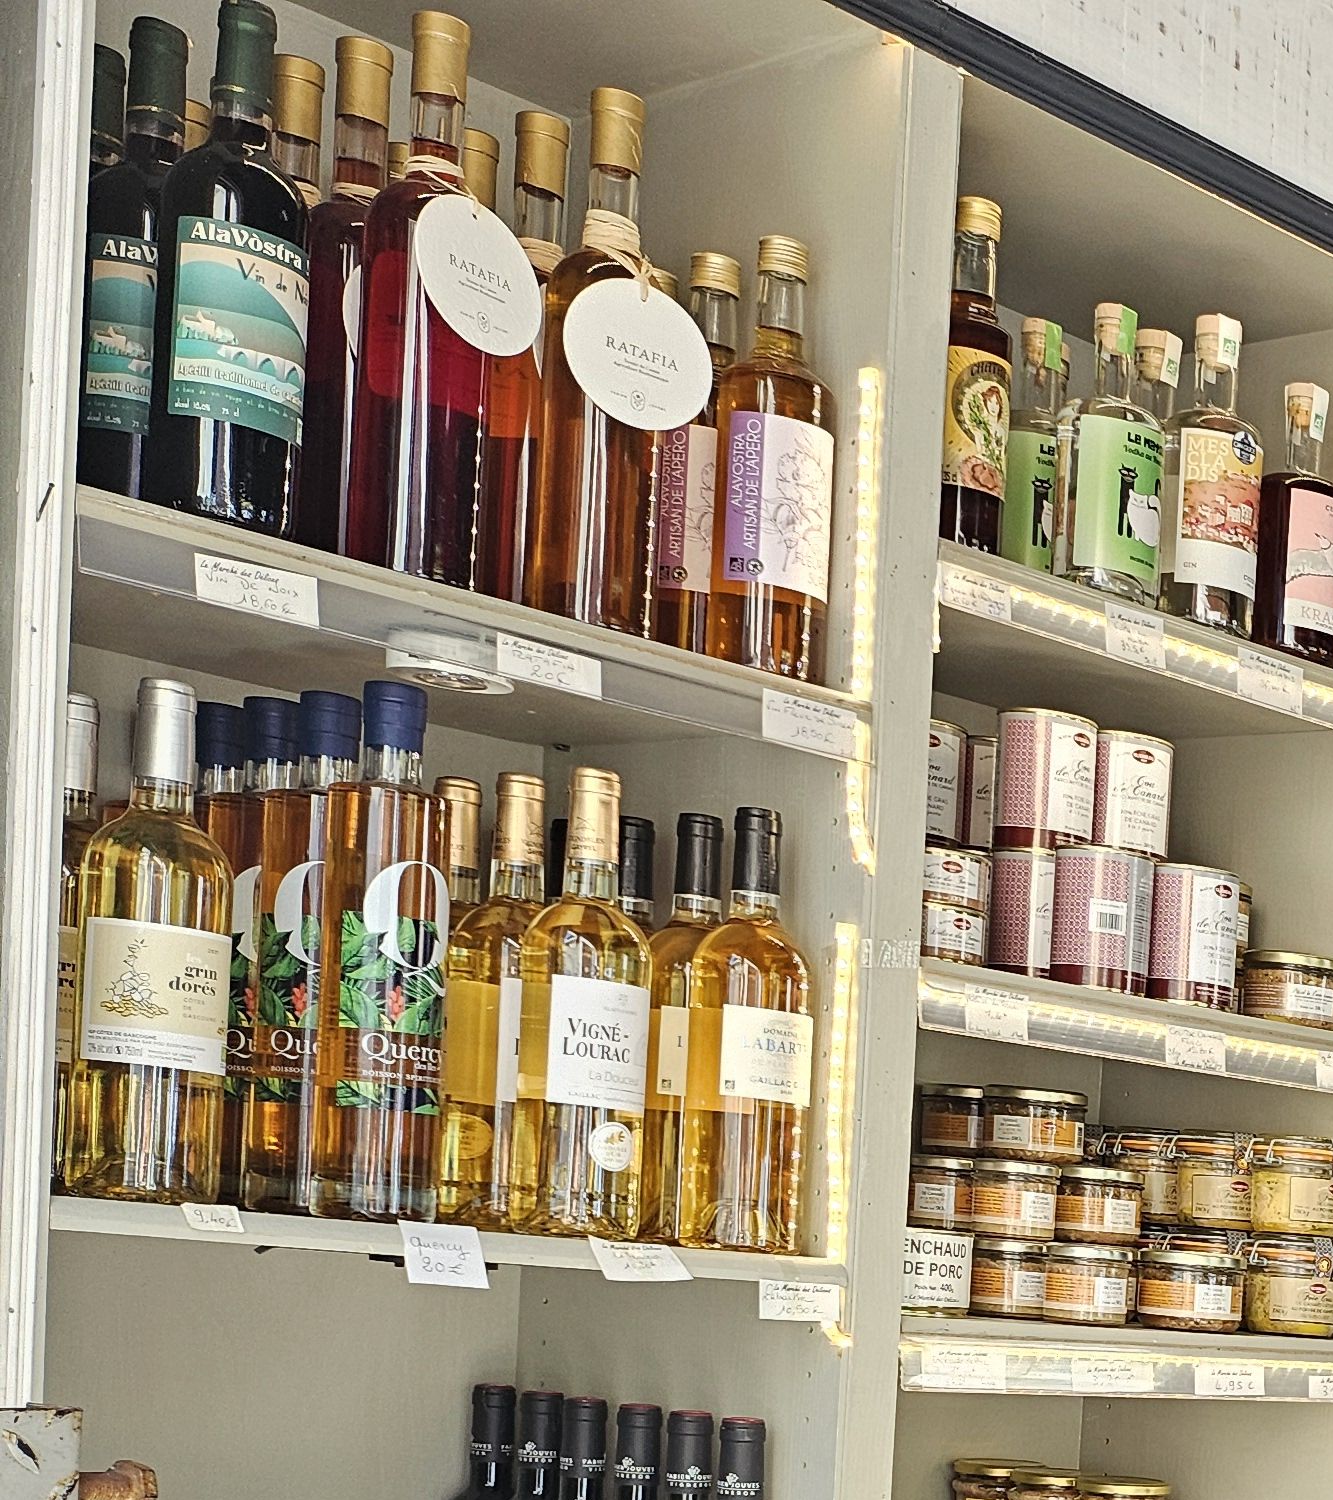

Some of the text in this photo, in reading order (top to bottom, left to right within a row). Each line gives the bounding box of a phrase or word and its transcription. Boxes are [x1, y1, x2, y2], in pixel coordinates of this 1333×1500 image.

[236, 258, 288, 292] Vin de
[449, 253, 512, 292] RATAFIA
[606, 335, 679, 373] RATAFIA
[1187, 436, 1229, 455] MES
[730, 433, 746, 507] ALAVOSTRA
[1186, 451, 1225, 468] CLA
[1185, 466, 1219, 482] DIS
[672, 489, 683, 509] DE
[750, 480, 760, 499] DE
[668, 510, 682, 558] ARTISAN
[743, 504, 760, 550] ARTISAN
[168, 976, 217, 997] dorés
[562, 1036, 631, 1065] LOURAC
[409, 1235, 471, 1262] Quercy
[903, 1260, 963, 1280] DE PORC
